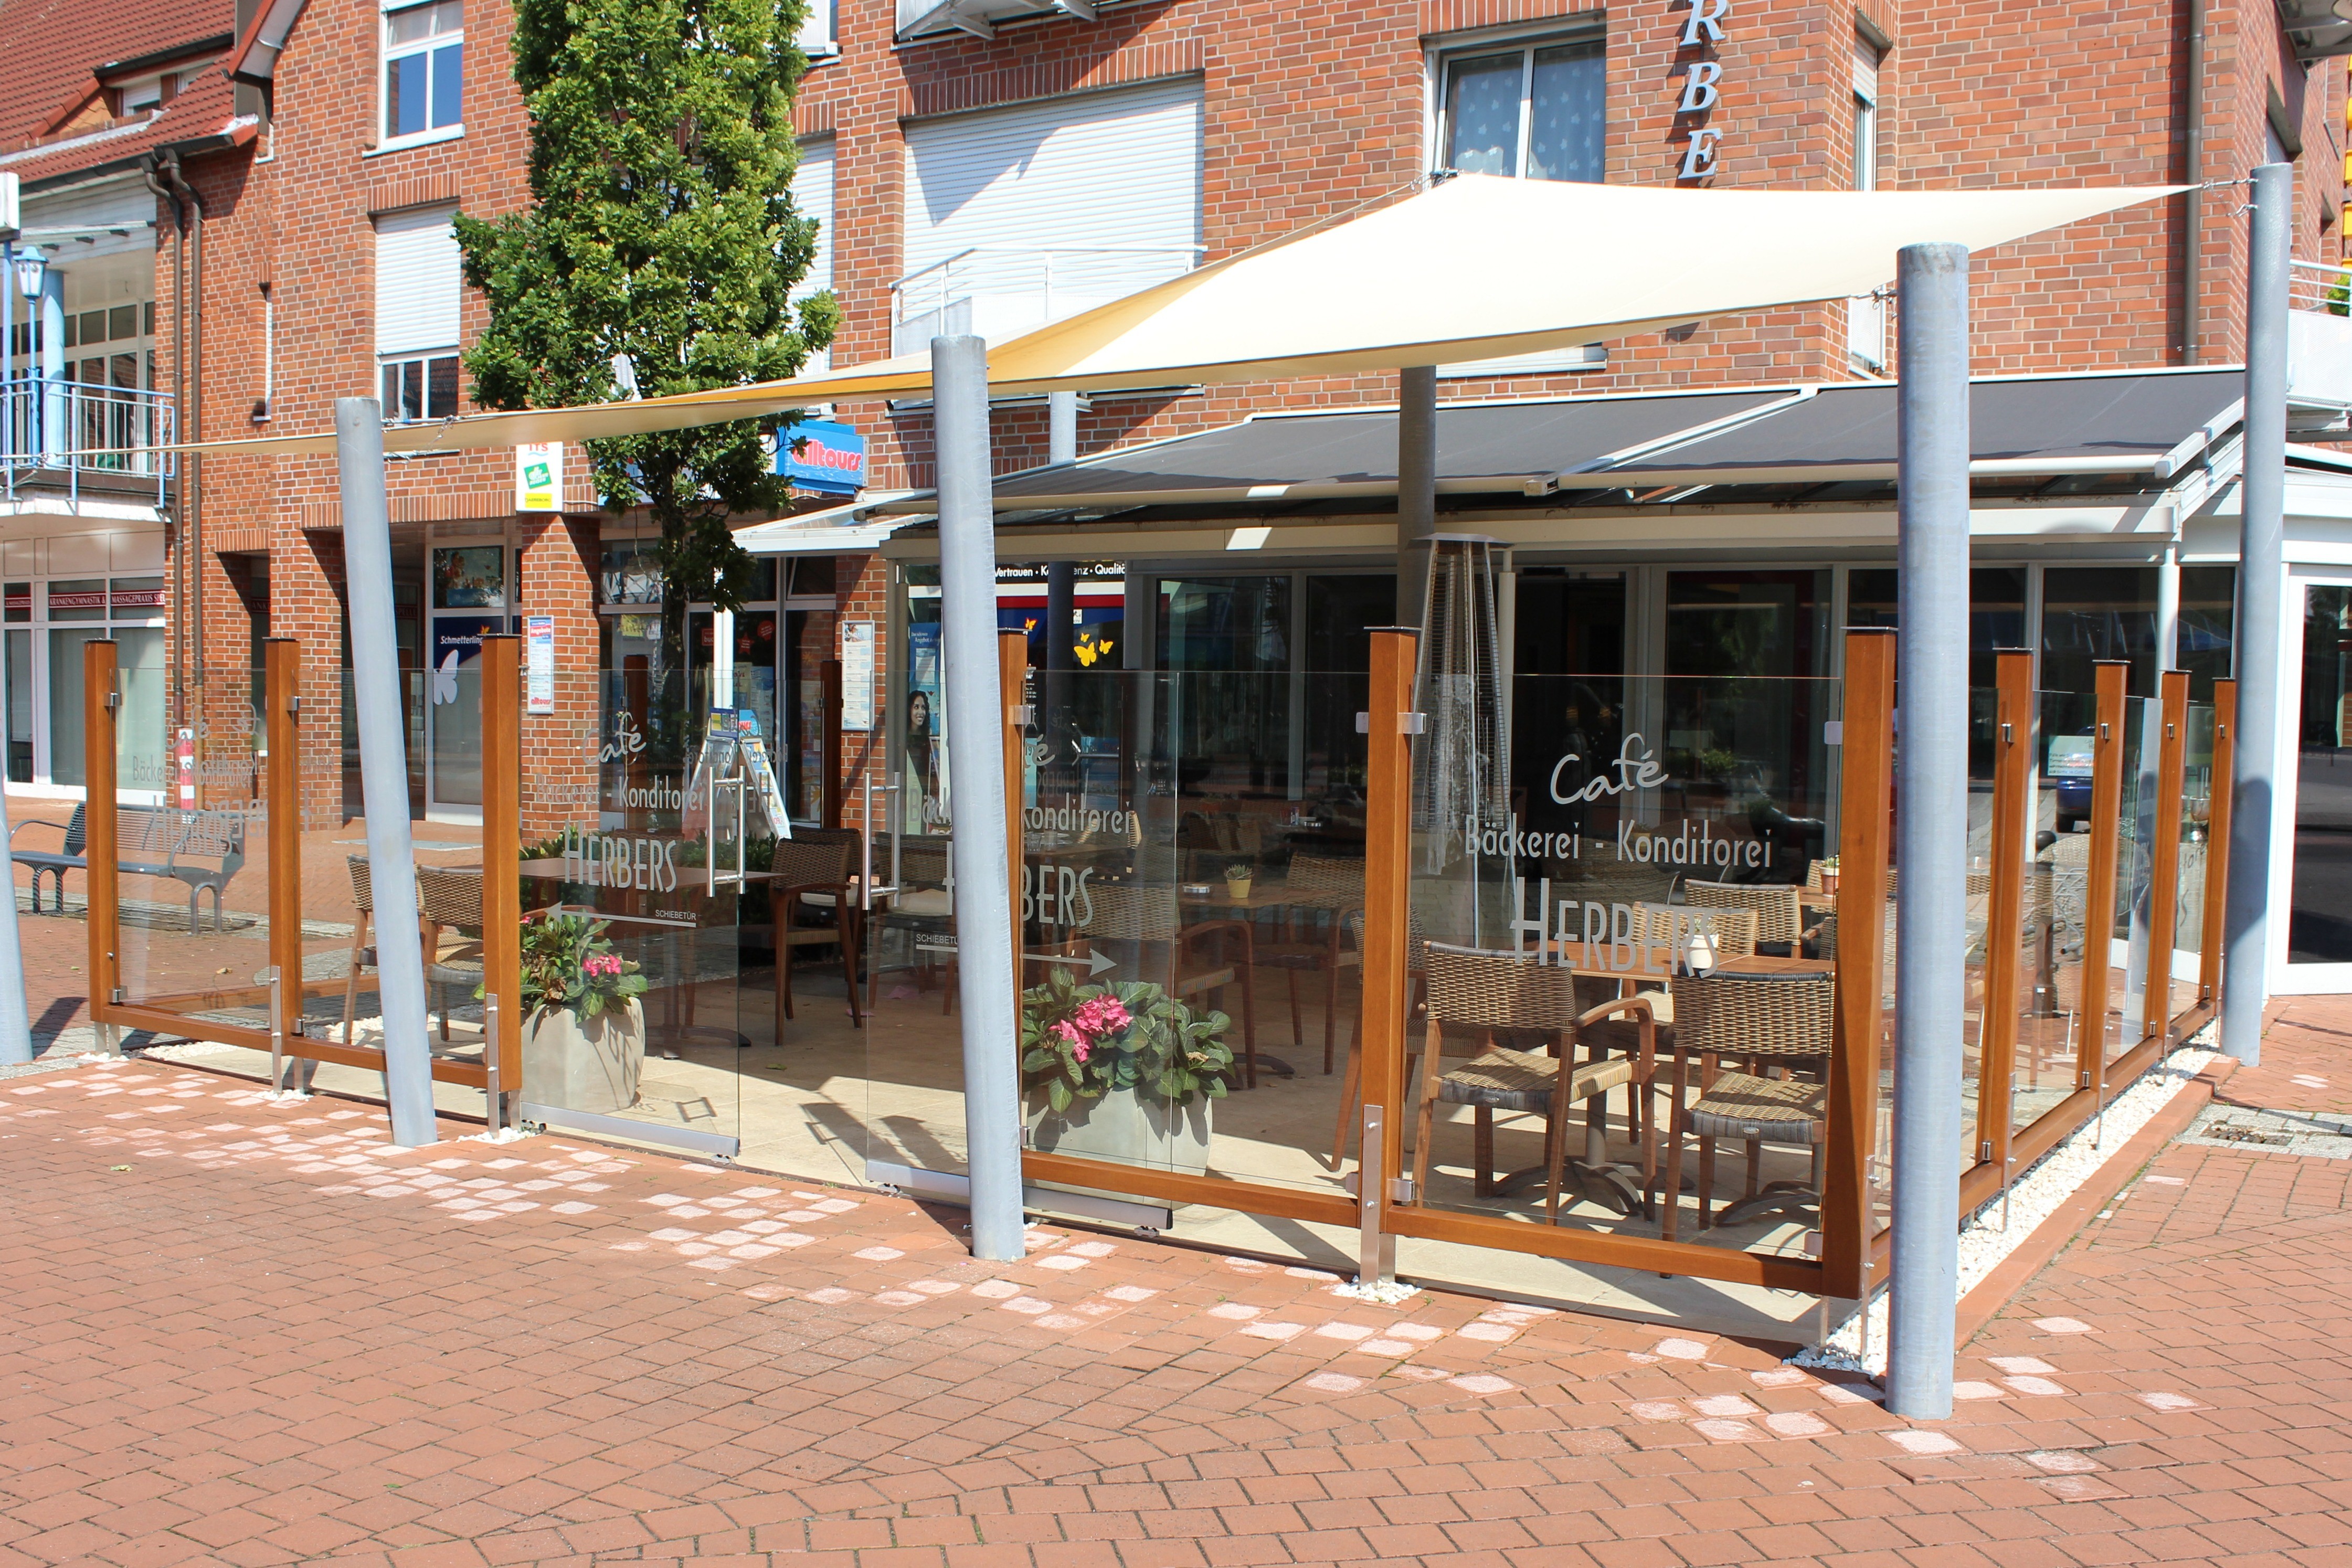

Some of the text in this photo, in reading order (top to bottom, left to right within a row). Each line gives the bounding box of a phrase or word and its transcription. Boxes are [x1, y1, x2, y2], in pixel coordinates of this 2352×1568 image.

[529, 442, 548, 451] ITS
[792, 438, 862, 472] alltours
[994, 567, 1033, 577] Vertrauen
[1095, 562, 1126, 575] Qualitä
[112, 594, 152, 603] MASSAGEPRAXIS
[440, 635, 483, 646] Schmetterling
[531, 626, 551, 635] Angebote
[582, 712, 647, 765] Café
[133, 756, 177, 784] Bäckerei
[1550, 733, 1669, 805] Café
[536, 771, 600, 805] Bäckerei
[619, 775, 704, 811] Konditorei
[1024, 792, 1130, 834] onditorei
[1465, 812, 1580, 859] Bäckerei
[1617, 819, 1771, 867] Konditorei
[562, 819, 677, 893] HERBERS
[655, 909, 697, 920] SCHIEBETÜR
[1509, 876, 1719, 979] HERBERS
[916, 934, 958, 945] SCHIEBETÜ
